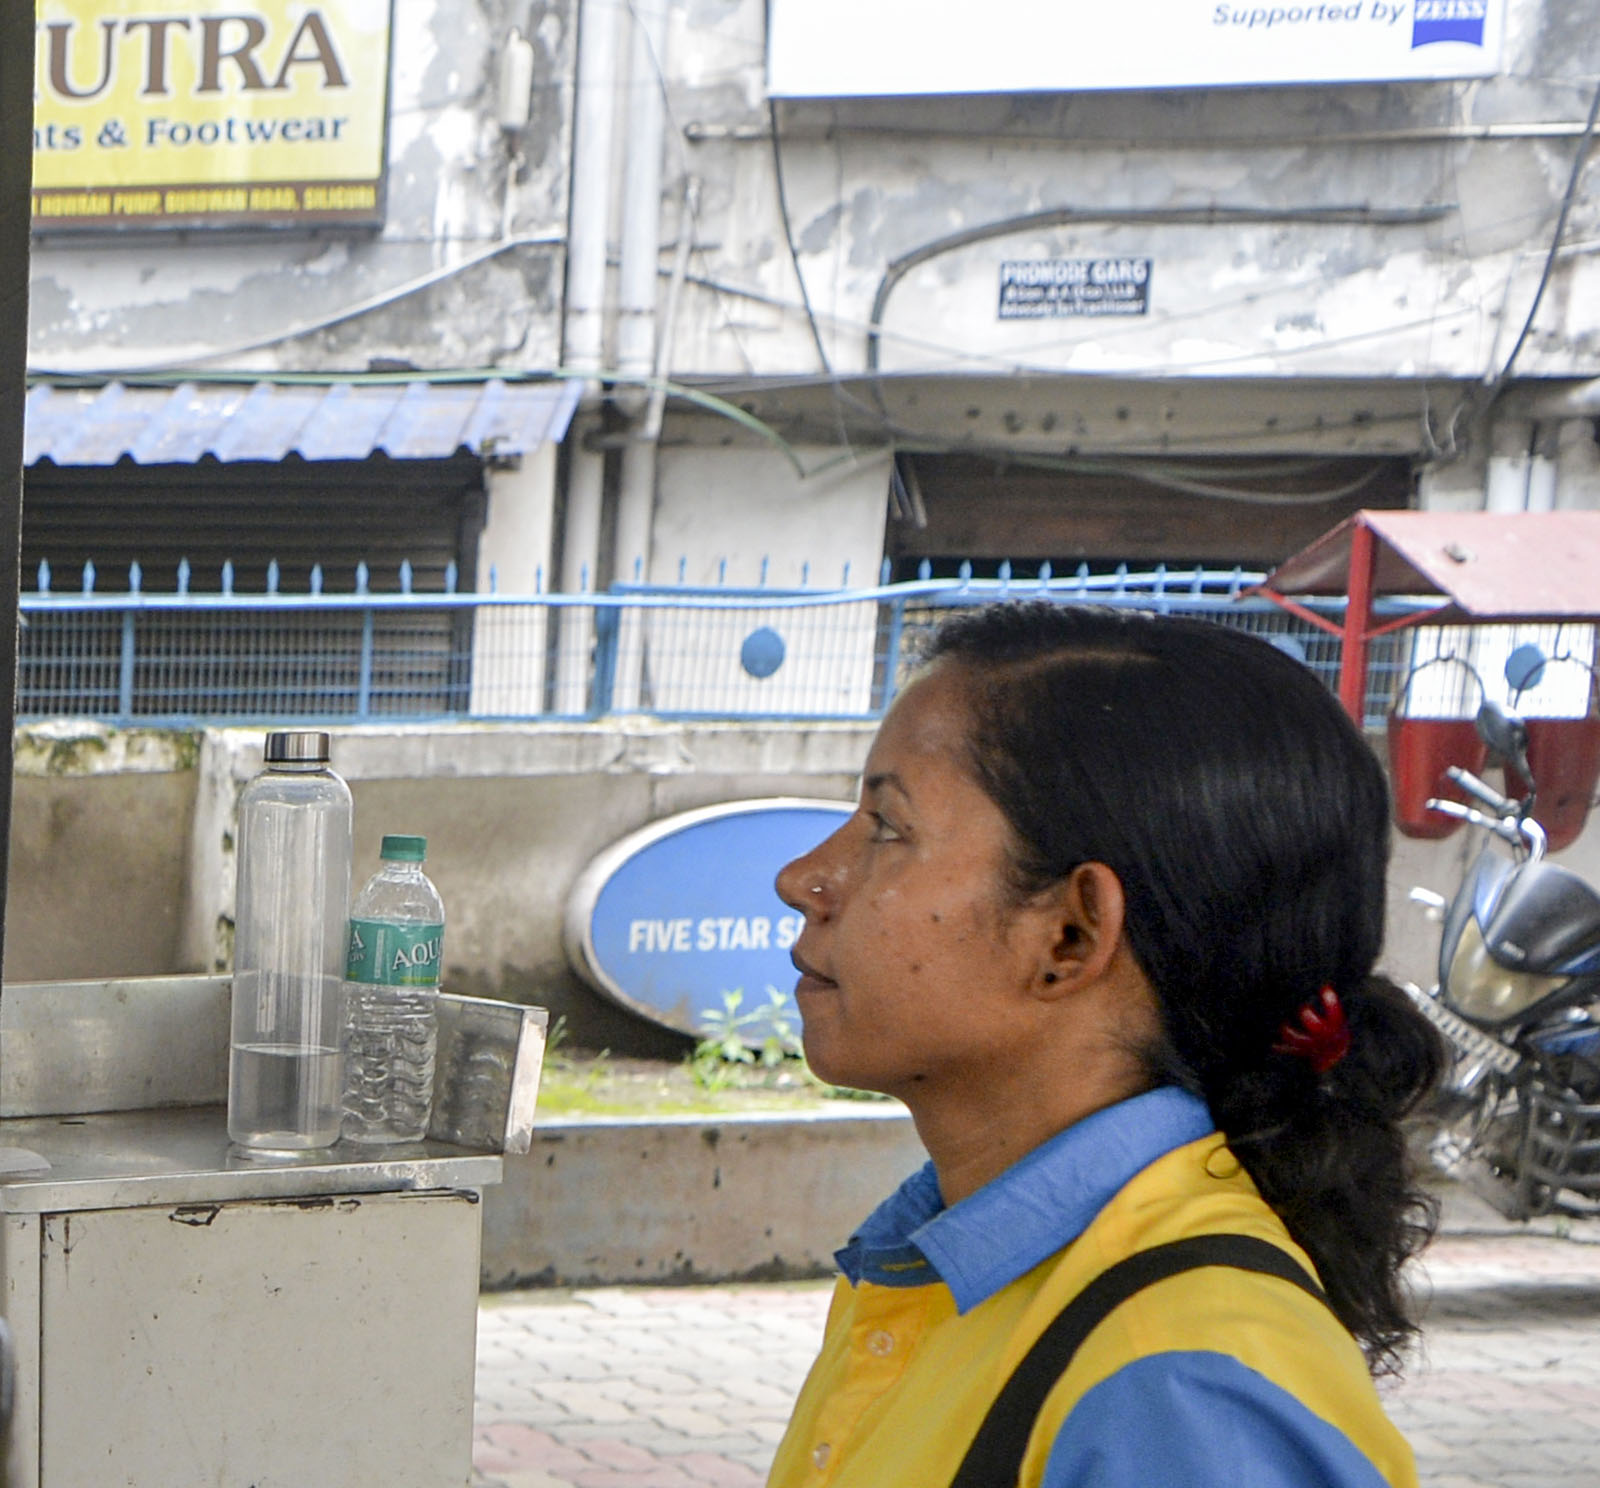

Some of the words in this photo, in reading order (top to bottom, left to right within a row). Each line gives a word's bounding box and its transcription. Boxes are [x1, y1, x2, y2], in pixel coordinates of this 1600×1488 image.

[1213, 1, 1361, 27] Supported
[1371, 0, 1405, 25] by
[97, 120, 127, 147] &
[146, 116, 348, 146] Footwear
[629, 918, 692, 953] FIVE
[697, 916, 769, 951] STAR
